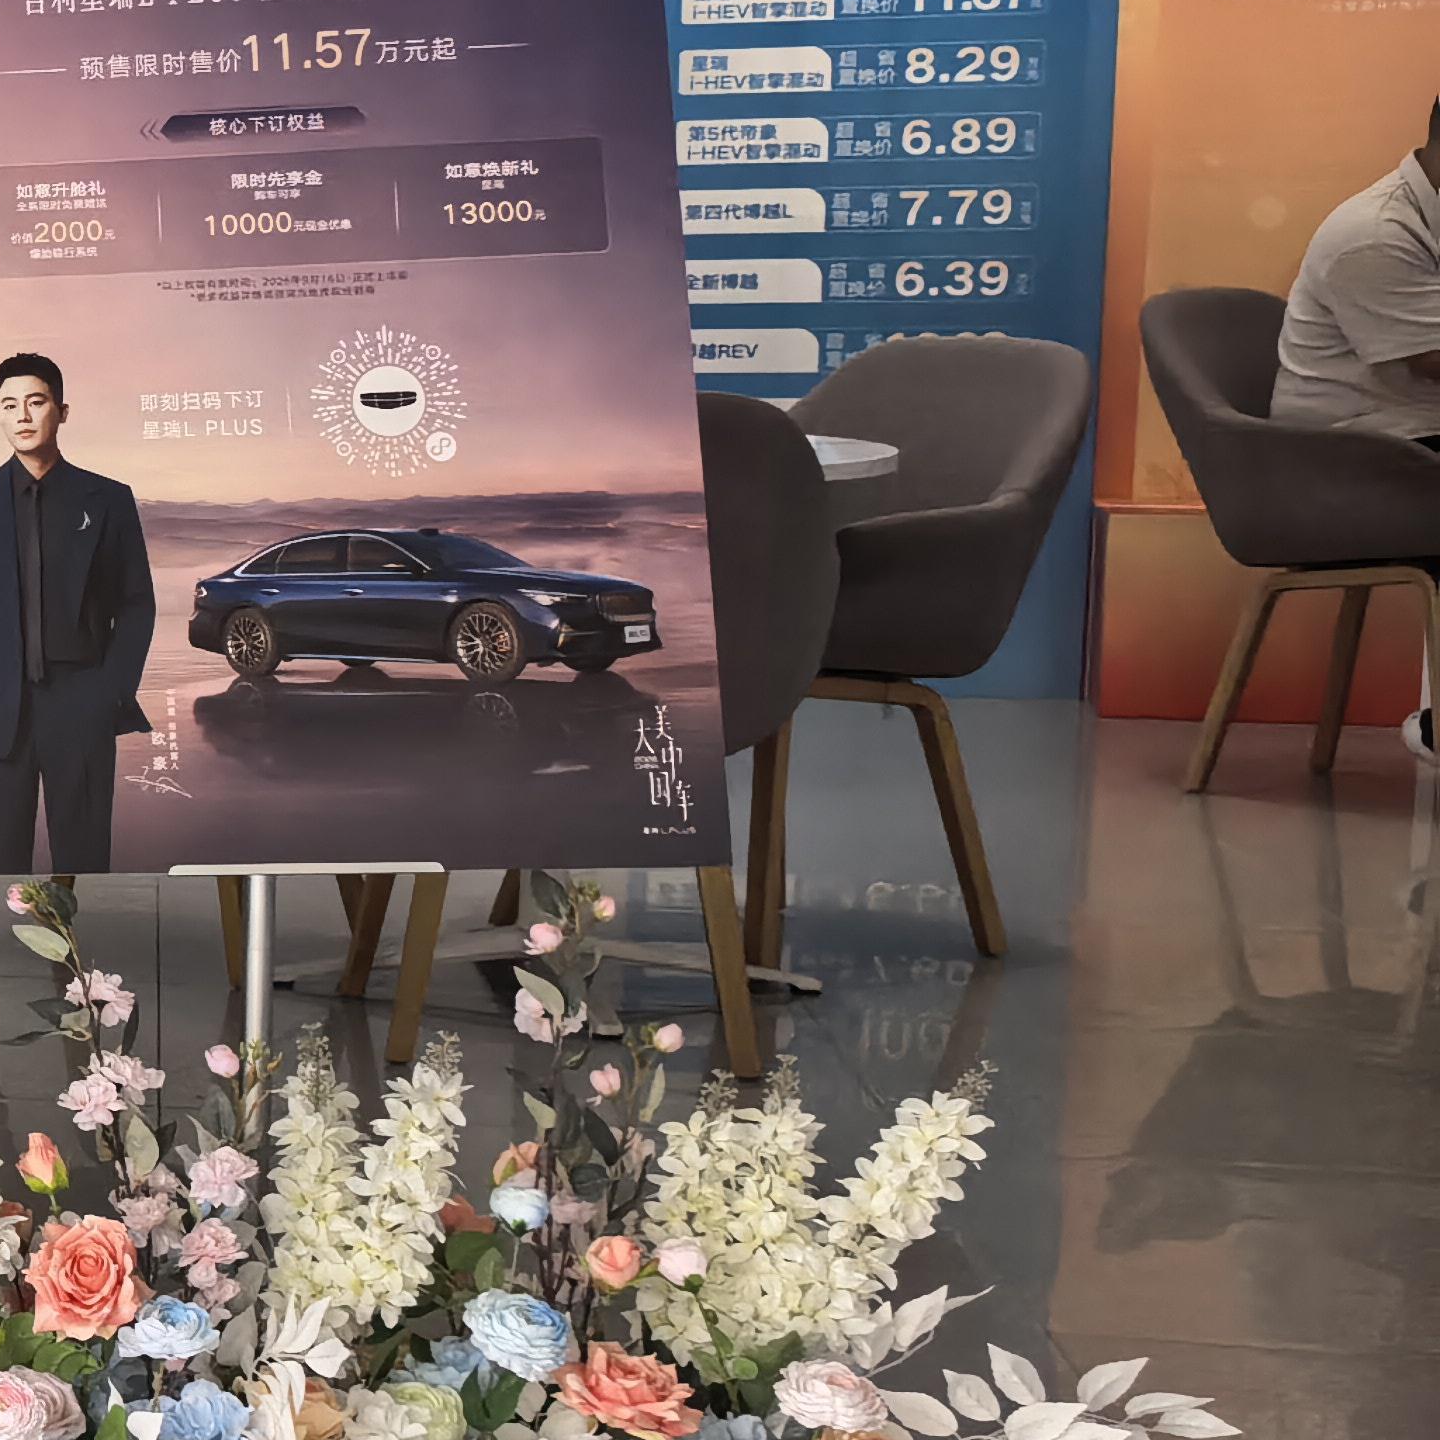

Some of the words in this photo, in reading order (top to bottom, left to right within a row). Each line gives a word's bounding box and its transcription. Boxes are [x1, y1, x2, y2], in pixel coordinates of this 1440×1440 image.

[905, 45, 1021, 85] 8.29
[209, 112, 325, 137] 核心下订权益
[901, 117, 1018, 156] 6.89
[231, 169, 323, 190] 限时先享金
[444, 159, 540, 179] 如意焕新礼
[16, 180, 106, 200] 如意升舱礼
[443, 200, 547, 225] 13000元
[899, 189, 1013, 226] 7.79
[894, 260, 1010, 297] 6.39
[140, 390, 264, 412] 即刻扫码下订
[206, 418, 263, 437] PLUS
